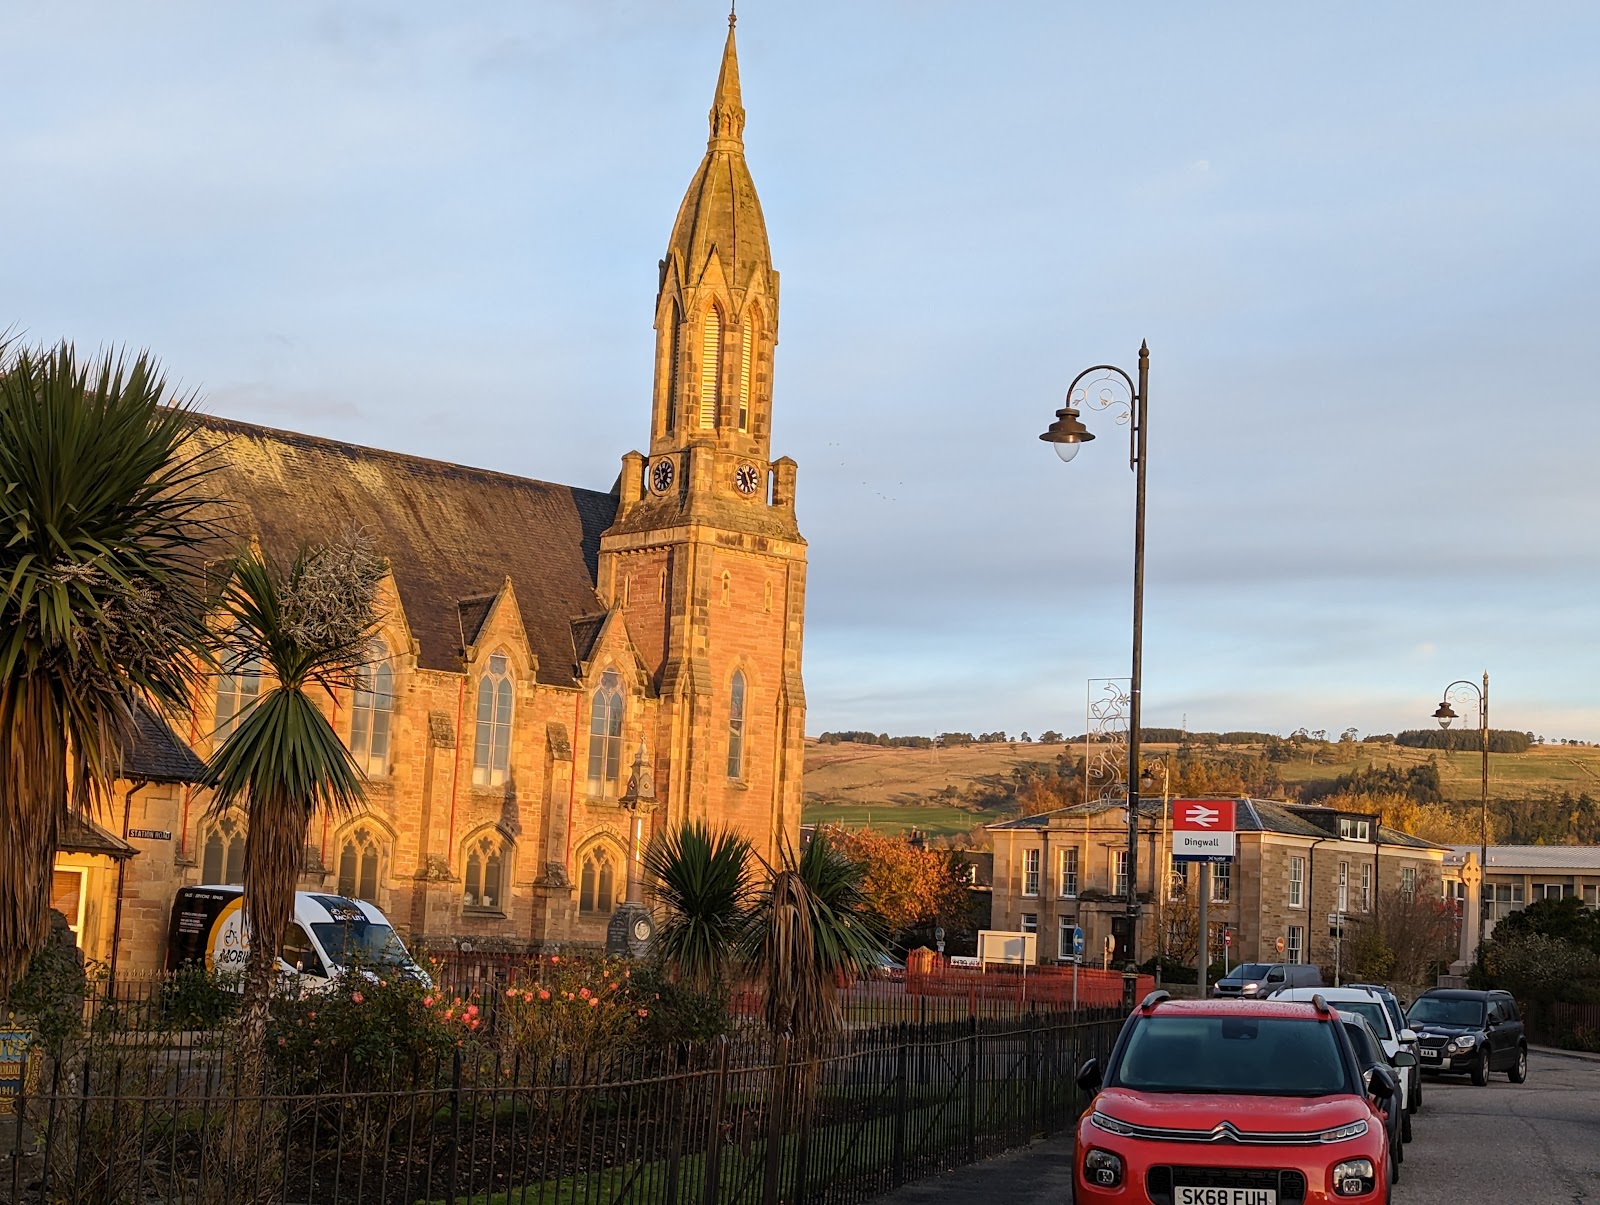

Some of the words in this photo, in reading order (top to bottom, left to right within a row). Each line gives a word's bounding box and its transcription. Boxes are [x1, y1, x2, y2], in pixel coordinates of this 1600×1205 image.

[1184, 837, 1219, 848] Dingwall
[1182, 1188, 1228, 1205] SK68
[1233, 1190, 1267, 1205] FUH
